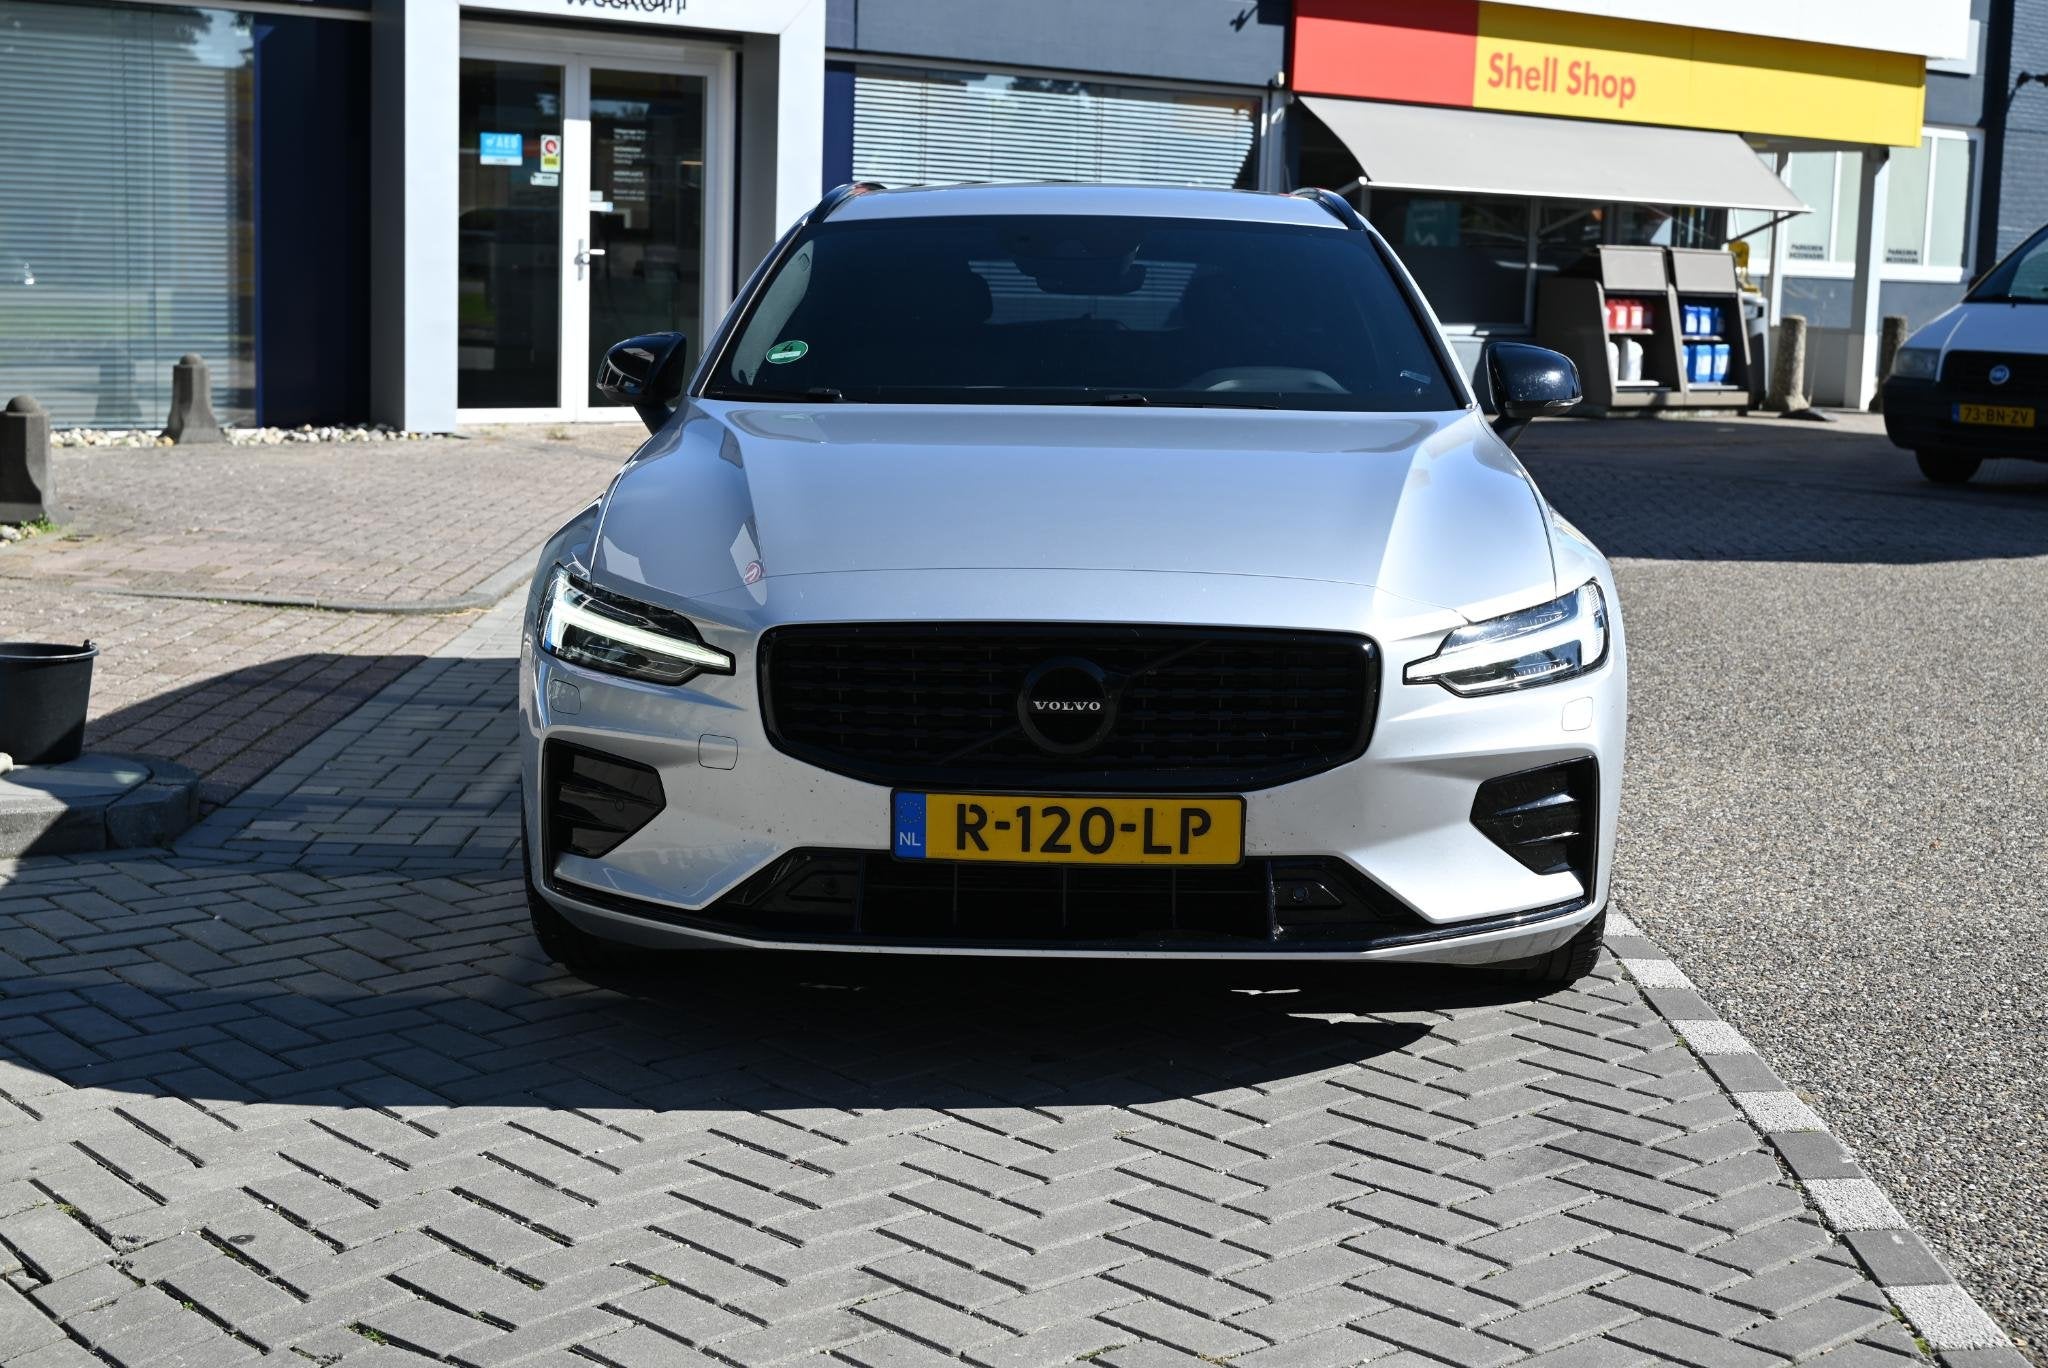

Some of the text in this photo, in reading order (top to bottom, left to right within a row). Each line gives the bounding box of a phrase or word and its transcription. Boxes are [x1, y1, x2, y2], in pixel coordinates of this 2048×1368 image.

[1488, 52, 1636, 109] Shell Shop
[1963, 407, 2029, 425] 73-BN-ZV
[1033, 701, 1101, 711] VOLVO
[956, 803, 1212, 855] R-120-LP
[899, 830, 921, 847] NL
